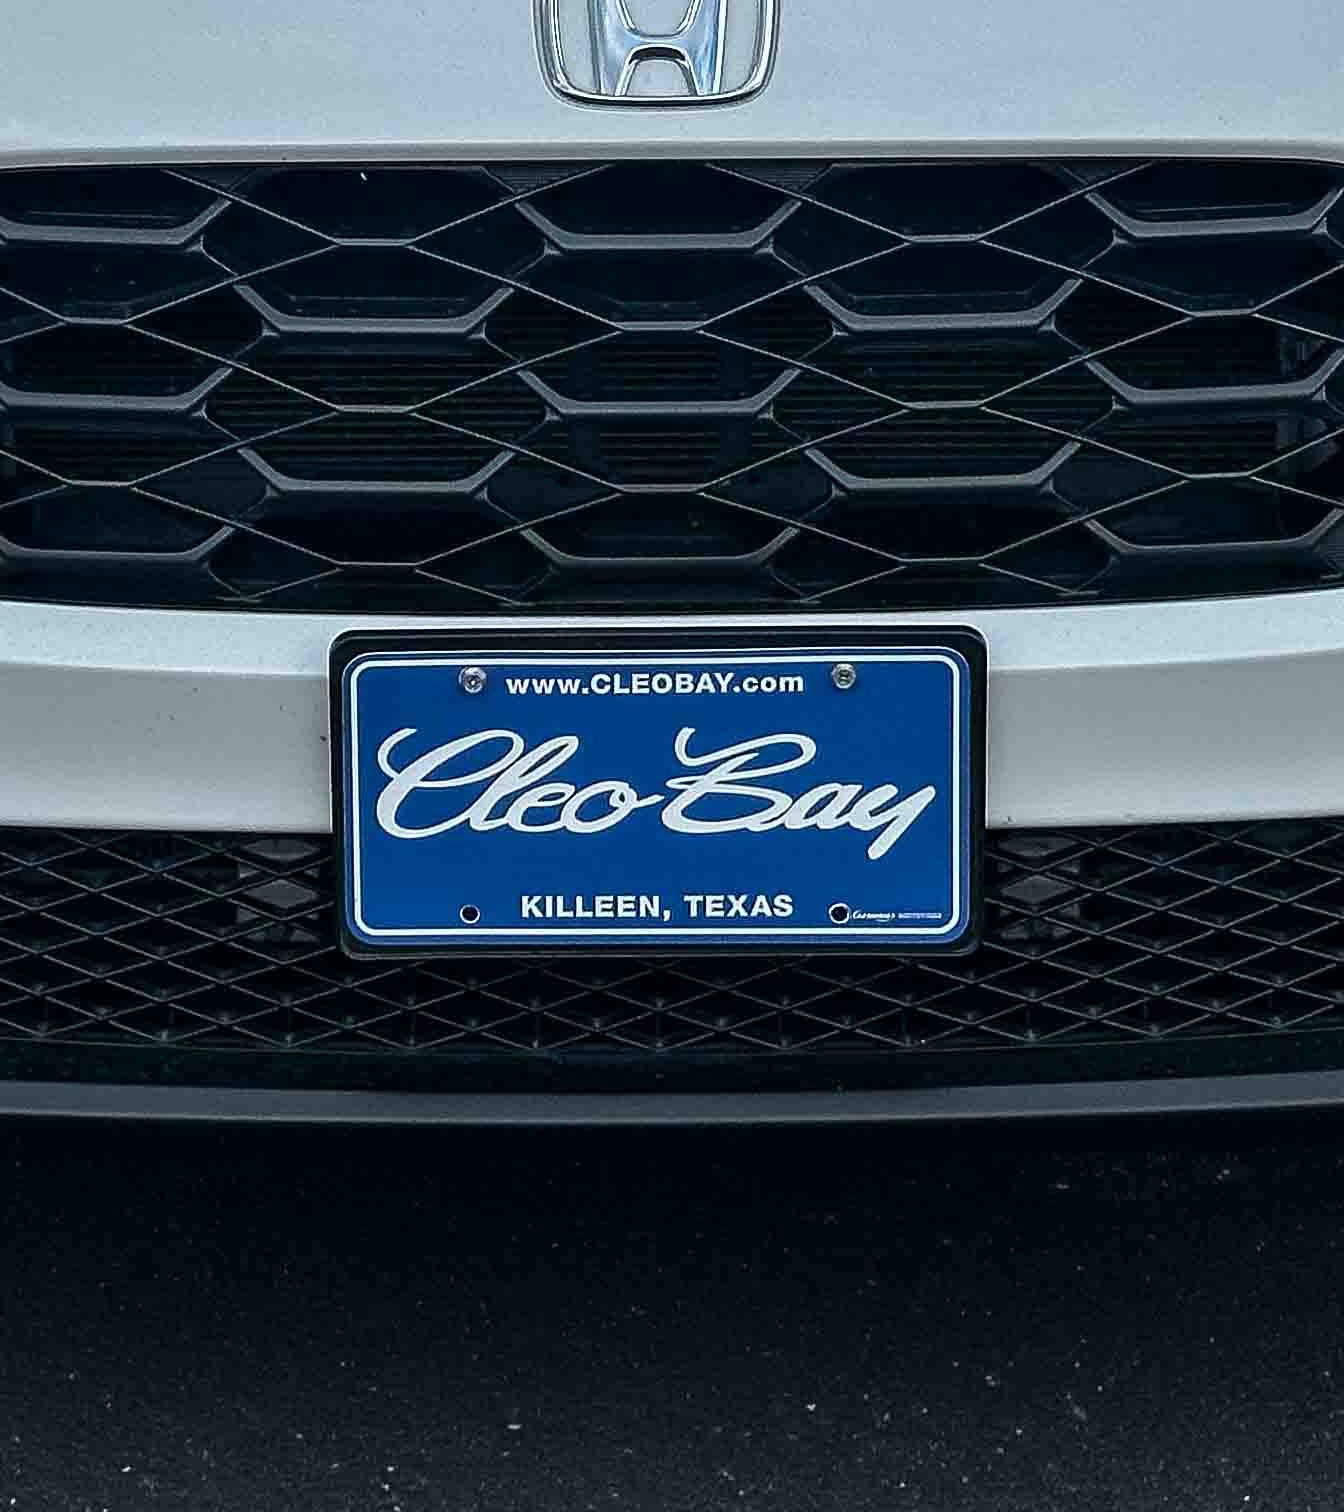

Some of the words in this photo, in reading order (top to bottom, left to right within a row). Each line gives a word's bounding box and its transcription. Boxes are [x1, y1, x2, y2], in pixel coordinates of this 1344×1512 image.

[505, 672, 805, 695] www.CLEOBAY.com
[376, 727, 665, 840] Cleo
[661, 727, 937, 861] Bay
[520, 895, 672, 922] KILLEEN,
[683, 893, 794, 918] TEXAS
